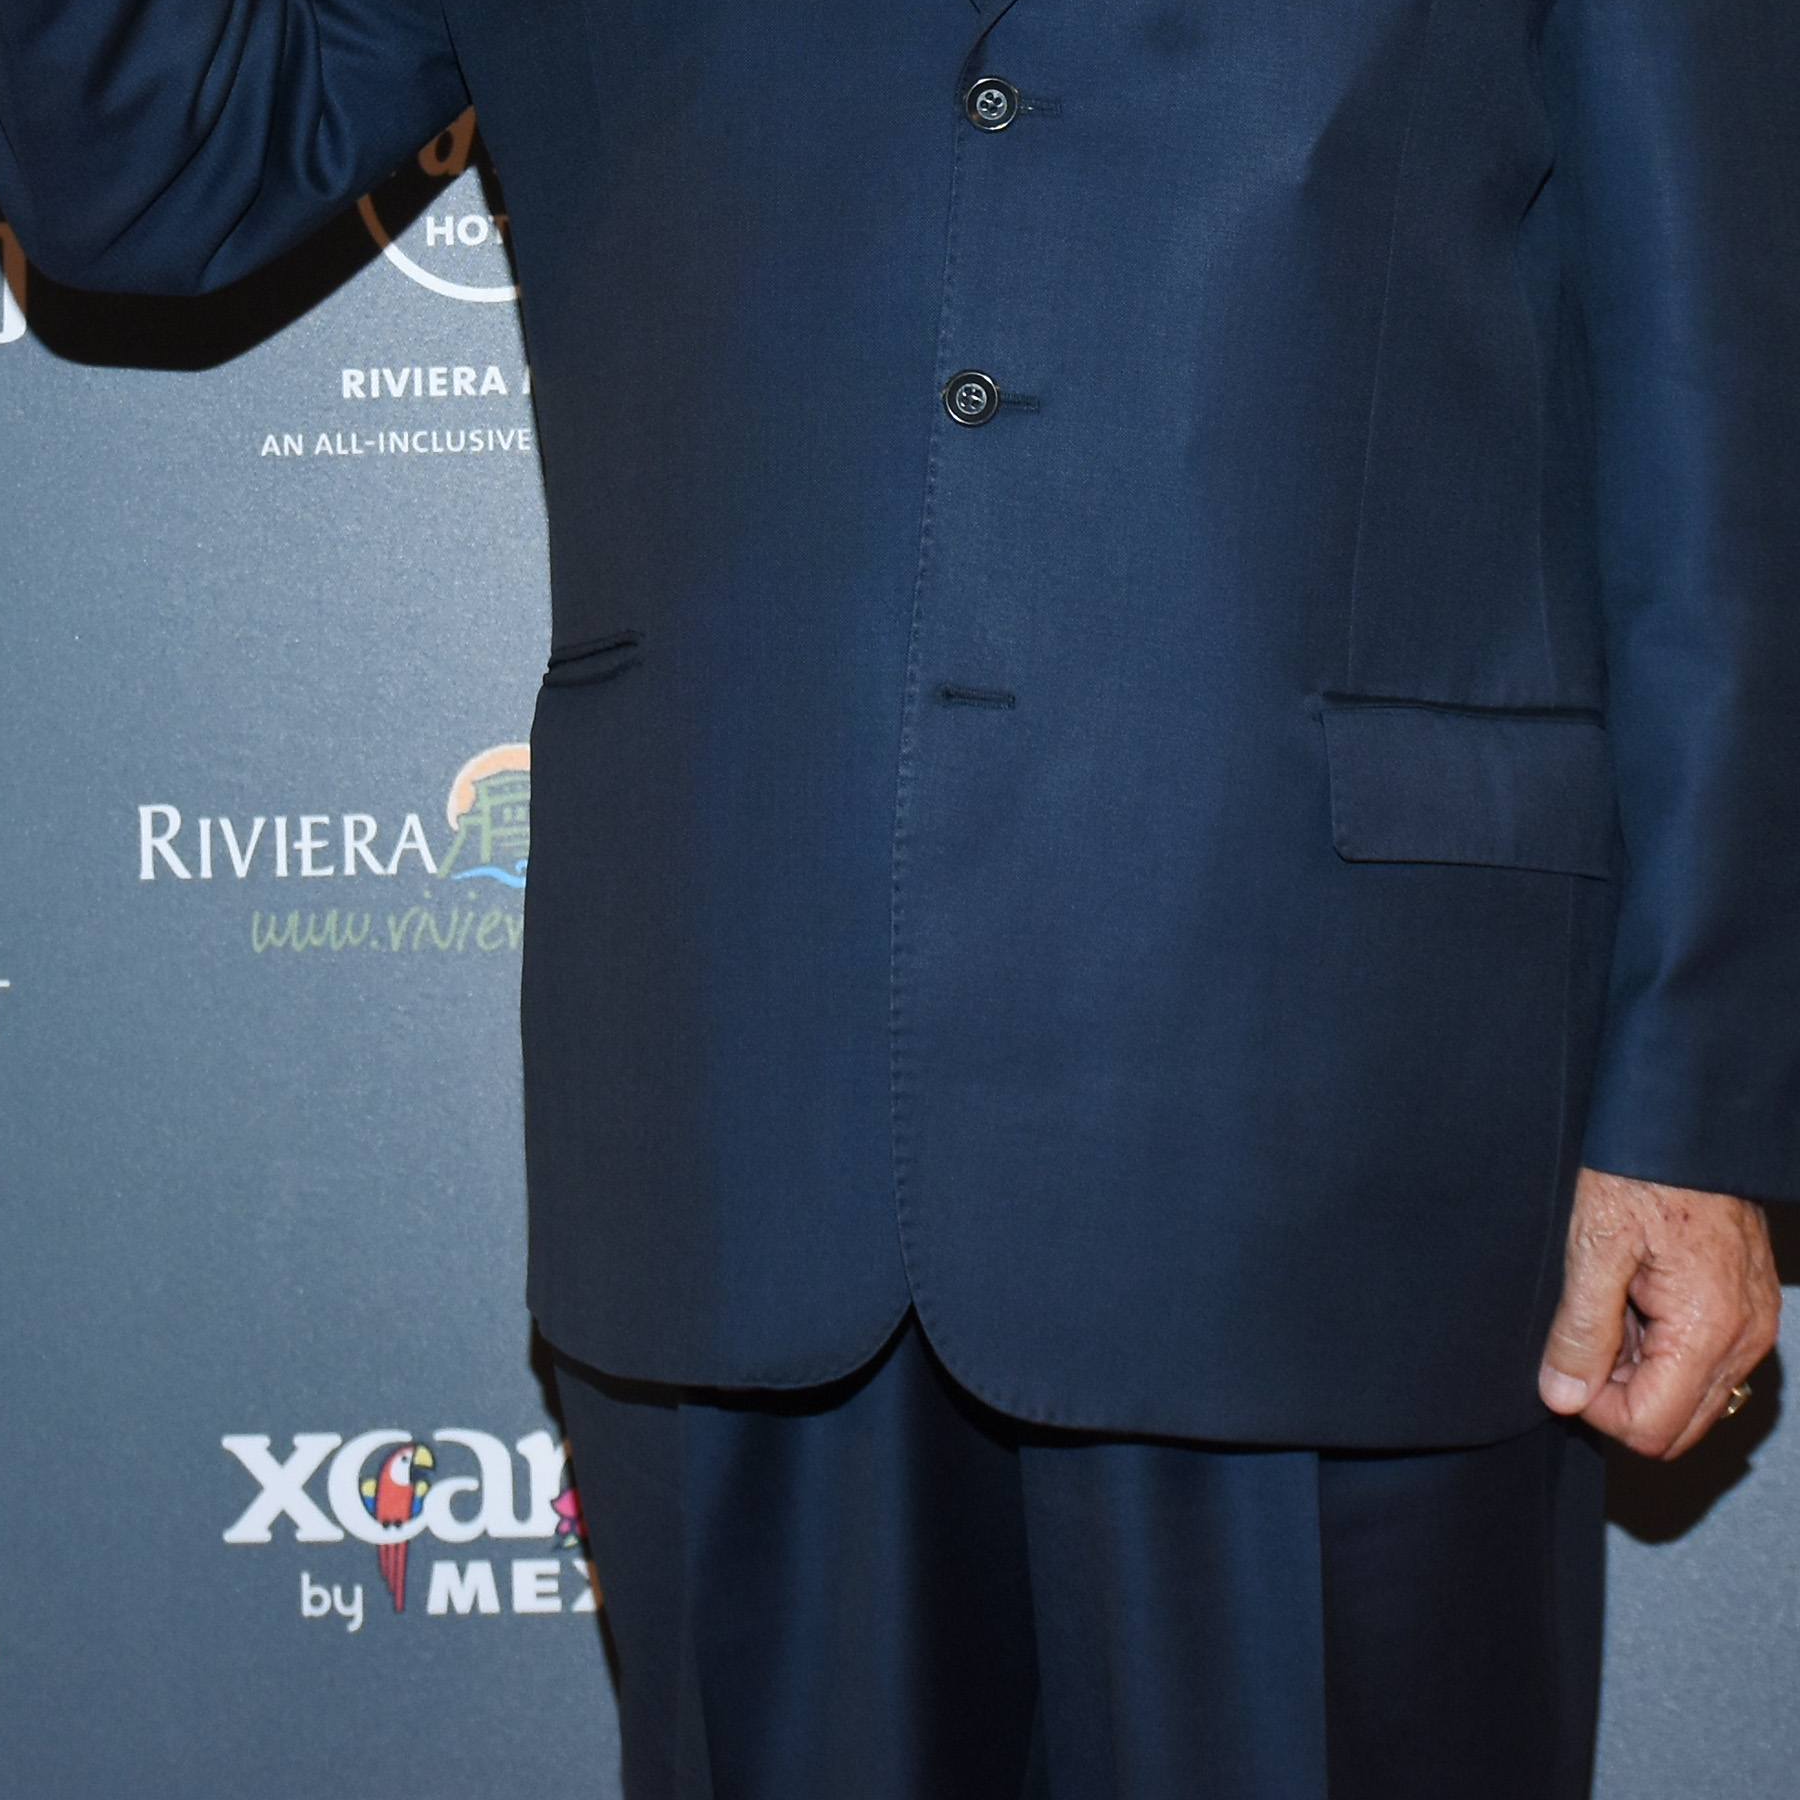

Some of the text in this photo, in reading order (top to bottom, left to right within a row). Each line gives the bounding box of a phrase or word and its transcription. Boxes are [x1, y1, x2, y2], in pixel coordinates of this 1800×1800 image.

[343, 366, 507, 398] RIVIERA
[261, 429, 530, 456] AN ALL-INCLUSIVE
[139, 805, 439, 879] RIVIERA
[220, 1427, 568, 1544] xcar
[301, 1572, 363, 1632] by
